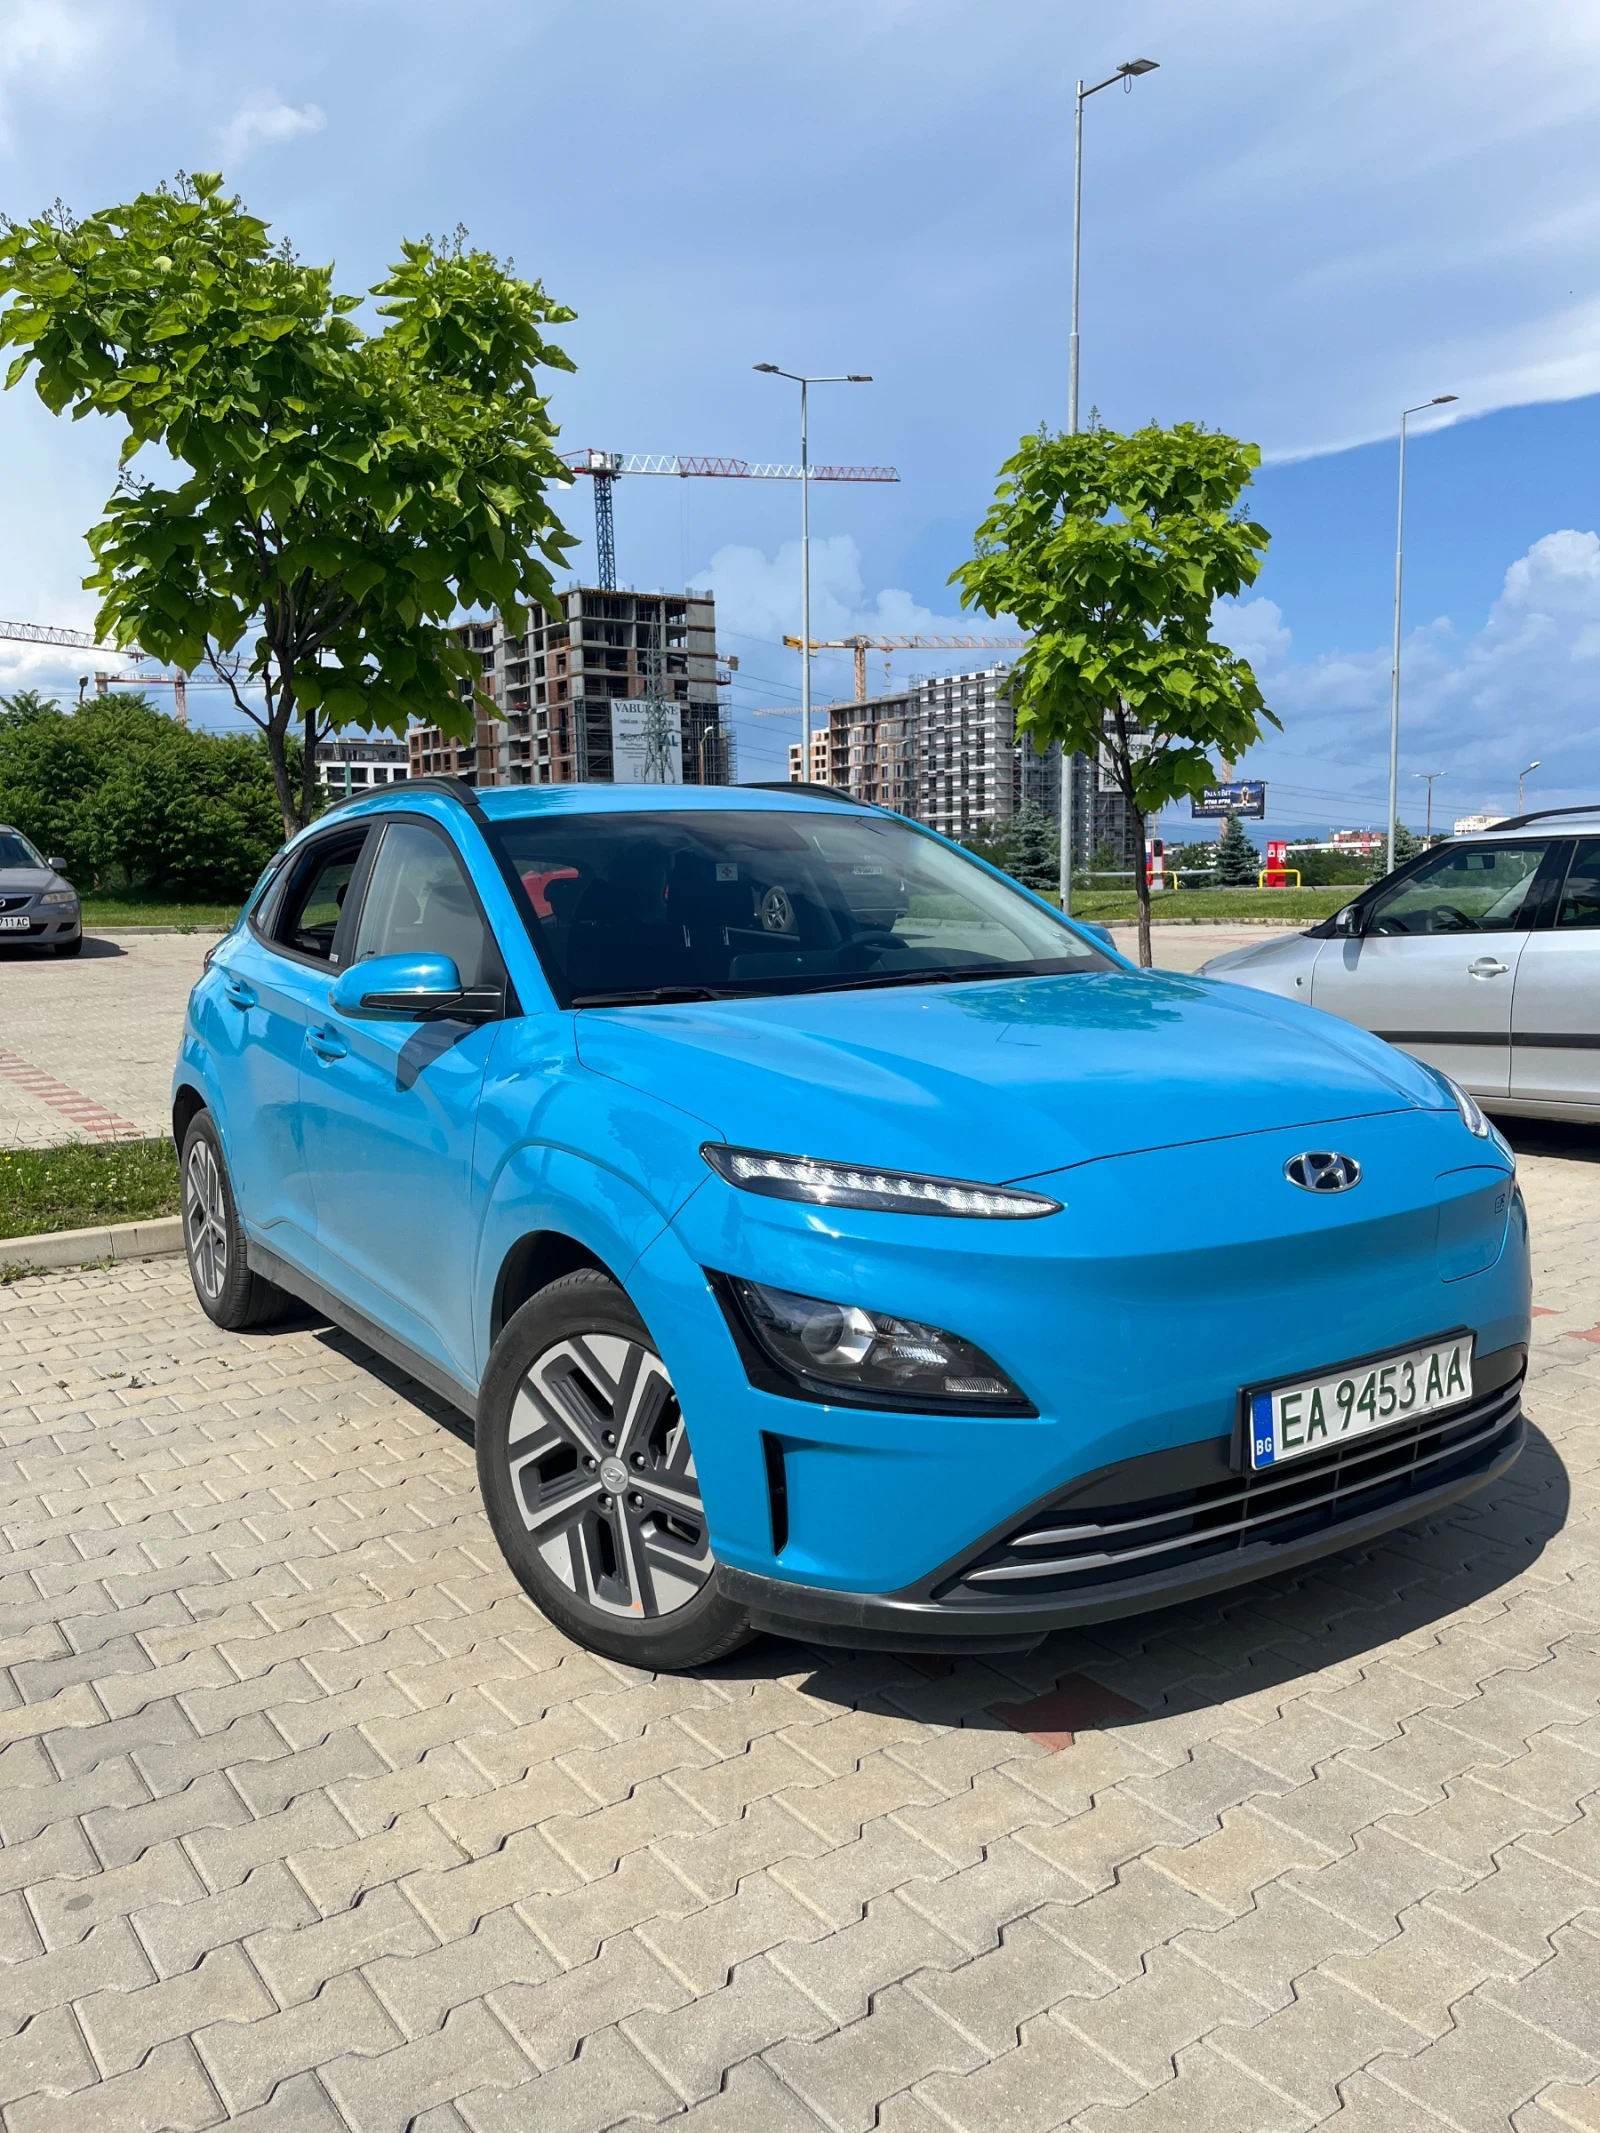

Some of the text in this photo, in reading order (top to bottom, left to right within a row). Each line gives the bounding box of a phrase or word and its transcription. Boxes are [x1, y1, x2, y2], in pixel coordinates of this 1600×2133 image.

[1280, 1346, 1466, 1450] EA 9453 AA
[1256, 1437, 1272, 1456] BG
